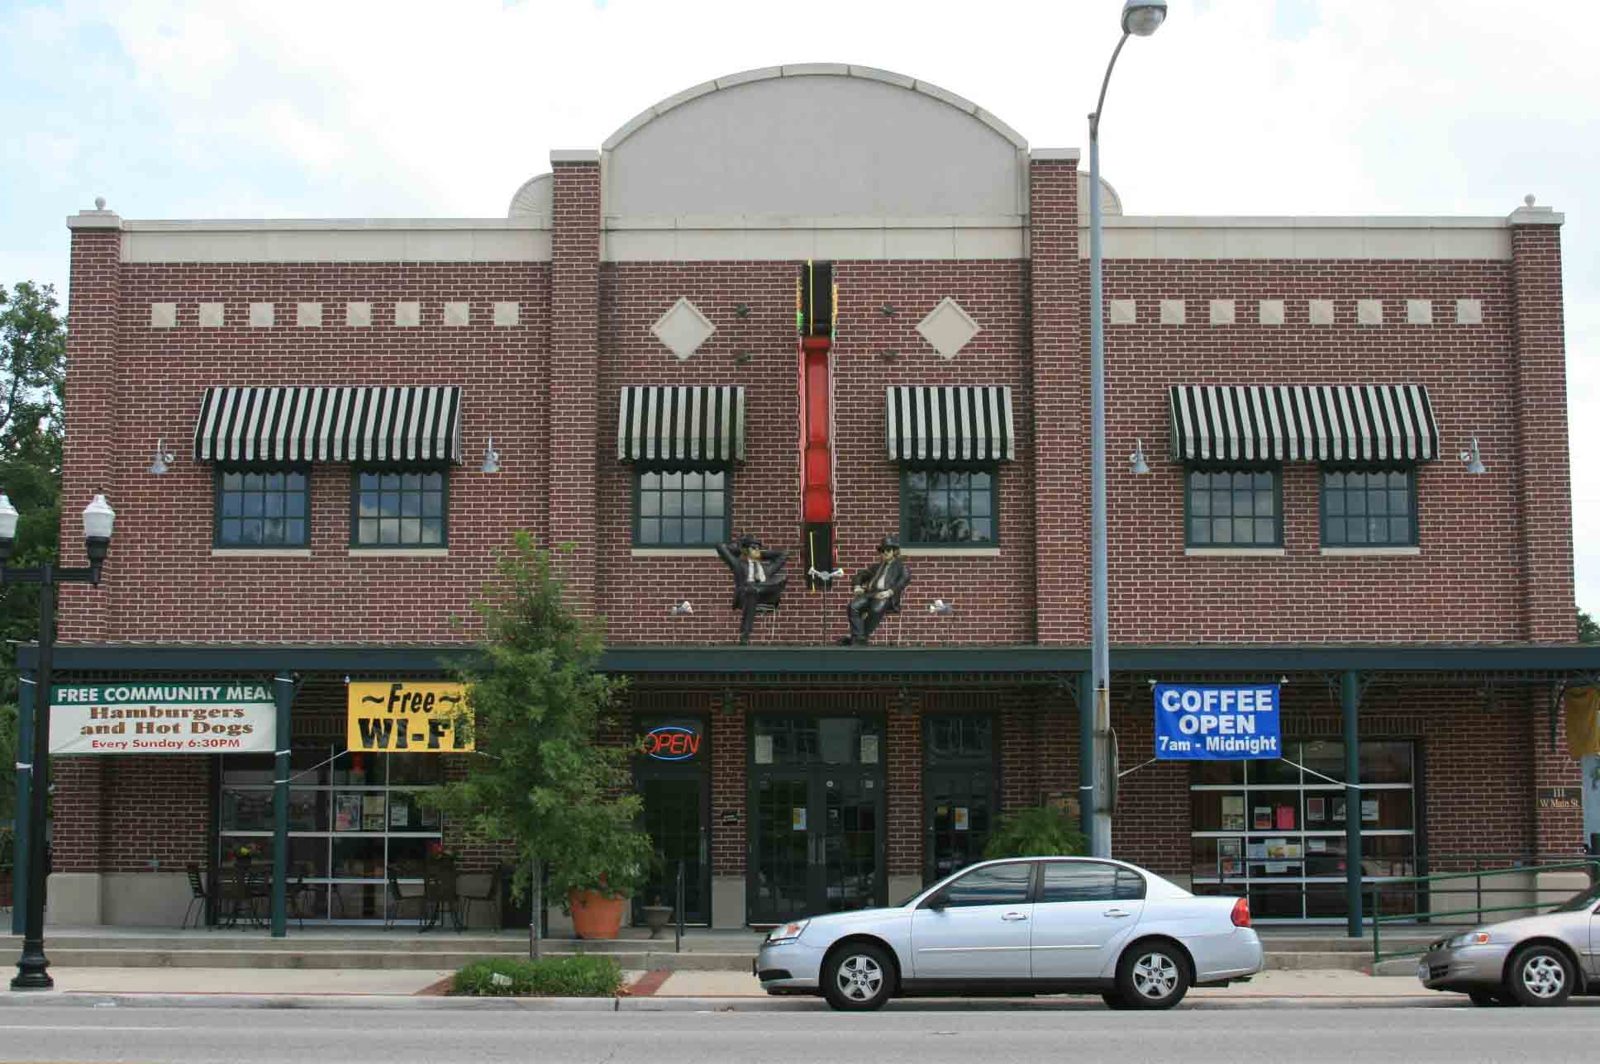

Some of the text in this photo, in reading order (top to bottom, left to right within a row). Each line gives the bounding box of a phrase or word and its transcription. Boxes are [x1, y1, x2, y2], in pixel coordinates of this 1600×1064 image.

[57, 688, 98, 702] FREE
[104, 686, 220, 701] COMMUNITY
[1161, 690, 1273, 712] COFFEE
[90, 706, 245, 721] Hamburgers
[80, 721, 254, 737] and Hot Dogs
[1178, 714, 1256, 734] OPEN
[92, 739, 240, 749] Every Sunday 6:30PM
[643, 733, 702, 754] OPEN
[1159, 736, 1191, 751] 7am
[1206, 735, 1277, 754] Midnight
